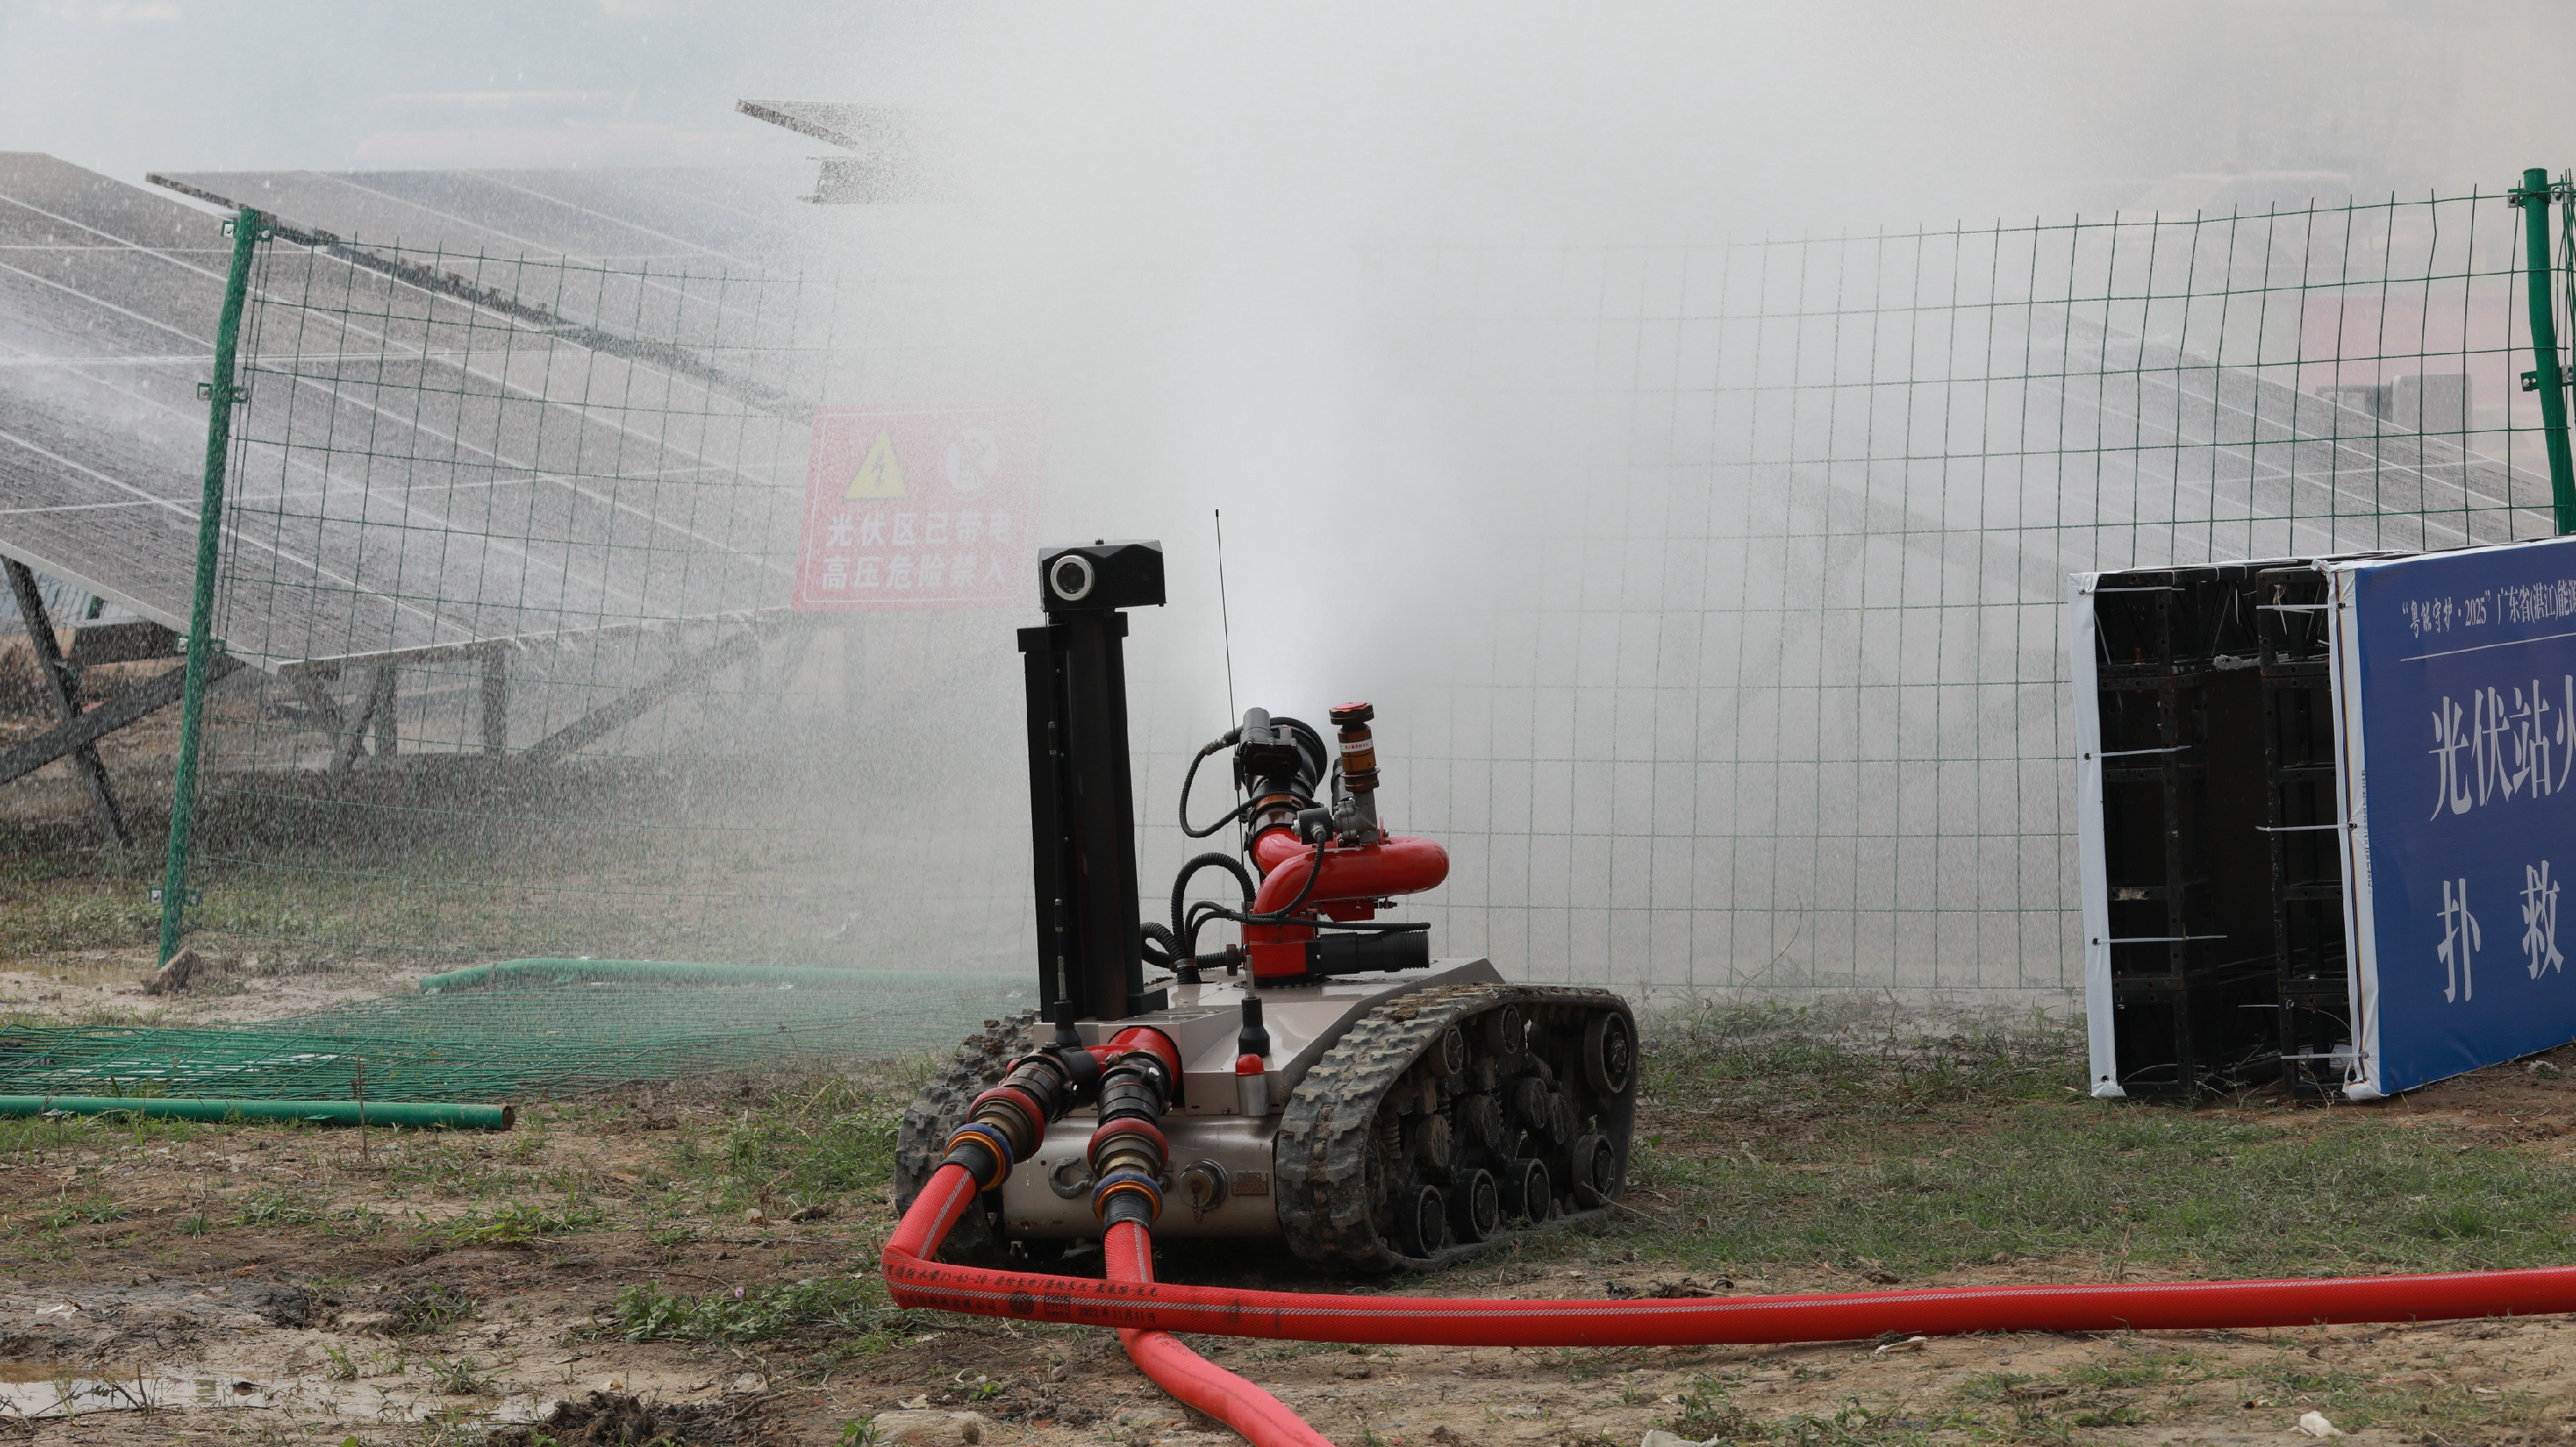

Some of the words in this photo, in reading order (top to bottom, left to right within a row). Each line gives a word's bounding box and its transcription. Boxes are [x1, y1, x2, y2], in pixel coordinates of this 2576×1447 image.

[825, 509, 1012, 547] 光伏区已带电
